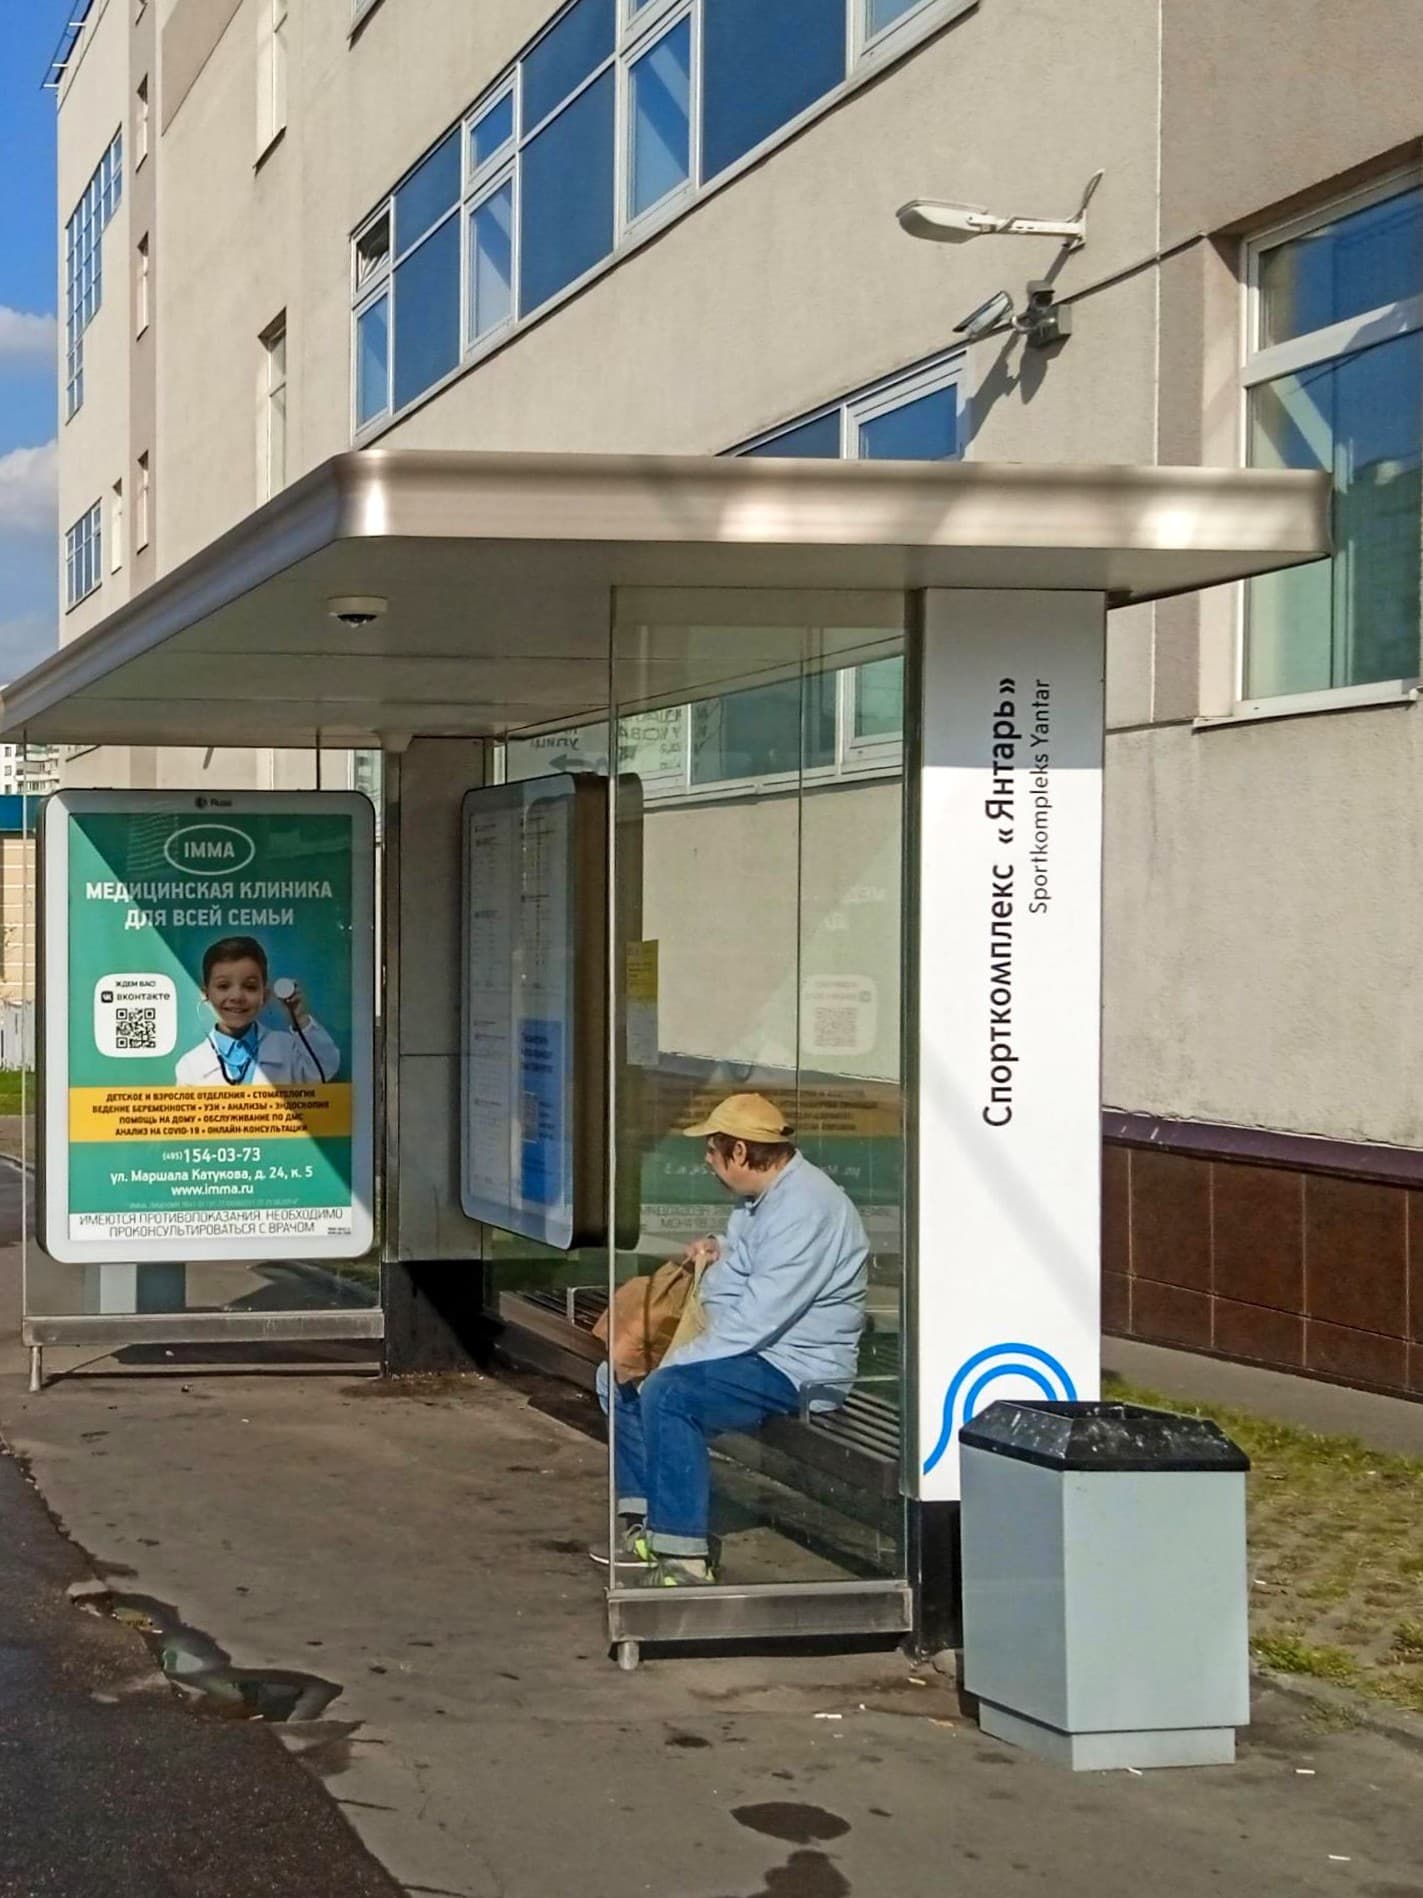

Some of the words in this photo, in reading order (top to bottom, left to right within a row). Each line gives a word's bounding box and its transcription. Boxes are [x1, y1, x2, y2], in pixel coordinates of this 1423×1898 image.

[1029, 679, 1051, 748] Yantar
[984, 677, 1022, 846] «Янтарь»
[1028, 753, 1054, 914] Sportkompleks
[184, 841, 235, 858] IMMA
[86, 881, 234, 903] МЕДИЦИНСКАЯ
[239, 881, 333, 899] КЛИНИКА
[124, 909, 167, 930] ДЛЯ
[173, 904, 222, 927] ВСЕЙ
[228, 908, 294, 926] СЕМЬИ
[982, 864, 1019, 1127] Спорткомплекс
[106, 1093, 143, 1102] ДЕТСКОЕ
[153, 1092, 195, 1100] ВЗРОСЛОЕ
[197, 1091, 245, 1100] ОТДЕЛЕНИЯ
[253, 1089, 315, 1099] СТОМАТОЛОГИЯ
[92, 1105, 130, 1114] ВЕДЕНИЕ
[132, 1104, 196, 1113] БЕРЕМЕННОСТИ
[204, 1103, 219, 1111] УЗИ
[228, 1102, 267, 1110] АНАЛИЗЫ
[119, 1116, 158, 1124] ПОМОЩЬ
[159, 1116, 170, 1124] НА
[172, 1115, 195, 1124] ДОМУ
[203, 1113, 269, 1123] ОБСЛУЖИВАНИЕ
[272, 1113, 283, 1121] ПО
[285, 1113, 304, 1122] ДМС
[115, 1128, 148, 1136] АНАЛИЗ
[183, 1147, 261, 1163] 154-03-73
[110, 1172, 128, 1185] ул.
[131, 1169, 189, 1184] Маршала
[191, 1168, 252, 1182] Катукова,
[269, 1167, 288, 1180] 24,
[305, 1165, 313, 1178] 5
[171, 1184, 254, 1196] www.imma.ru
[79, 1213, 136, 1225] ИМЕЮТСЯ
[266, 1208, 343, 1221] НЕОБХОДИМО
[109, 1223, 256, 1237] ПРОКОНСУЛЬТИРОВАТЬСЯ
[259, 1222, 266, 1233] С
[268, 1220, 315, 1233] ВРАЧОМ
